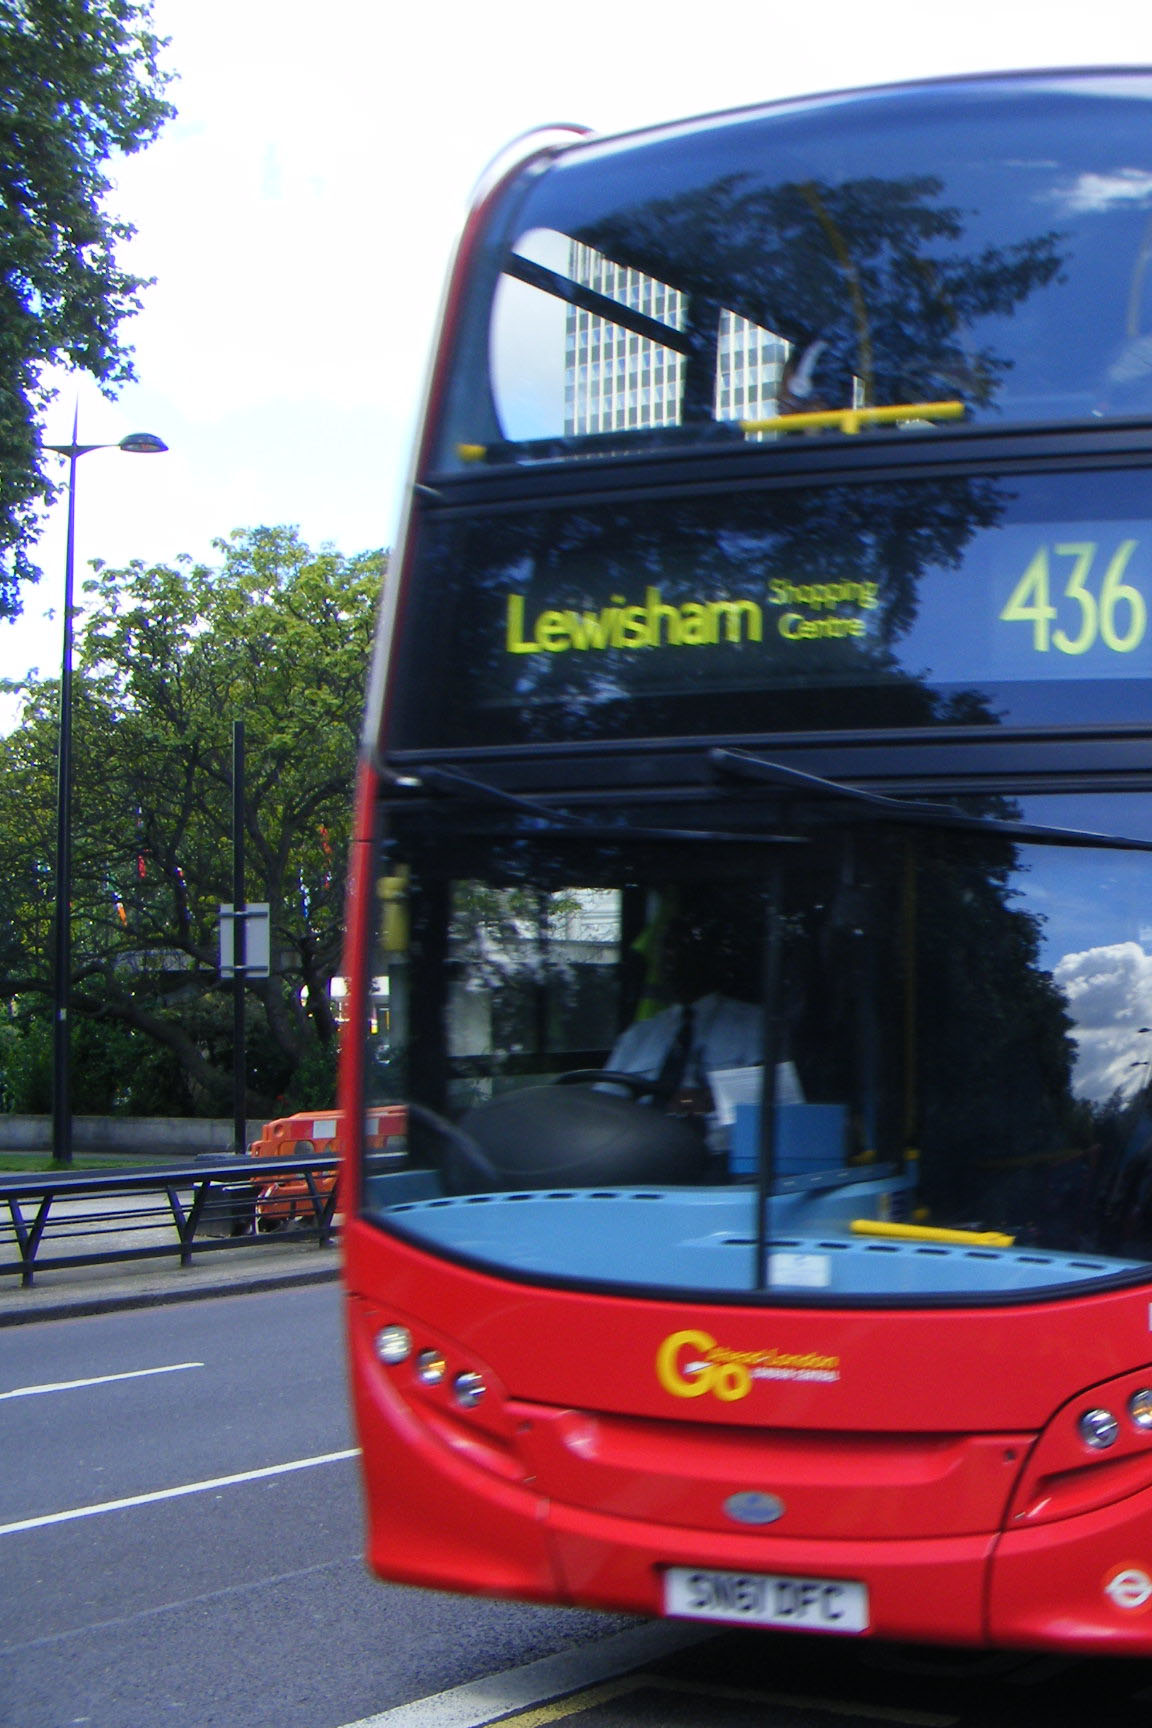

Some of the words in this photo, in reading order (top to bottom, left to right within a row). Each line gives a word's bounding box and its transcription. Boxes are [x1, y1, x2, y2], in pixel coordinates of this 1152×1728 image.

[507, 587, 762, 653] Lewisham
[767, 578, 879, 610] Shopping
[777, 612, 867, 640] Centre
[999, 540, 1148, 655] 436
[656, 1329, 752, 1403] Go
